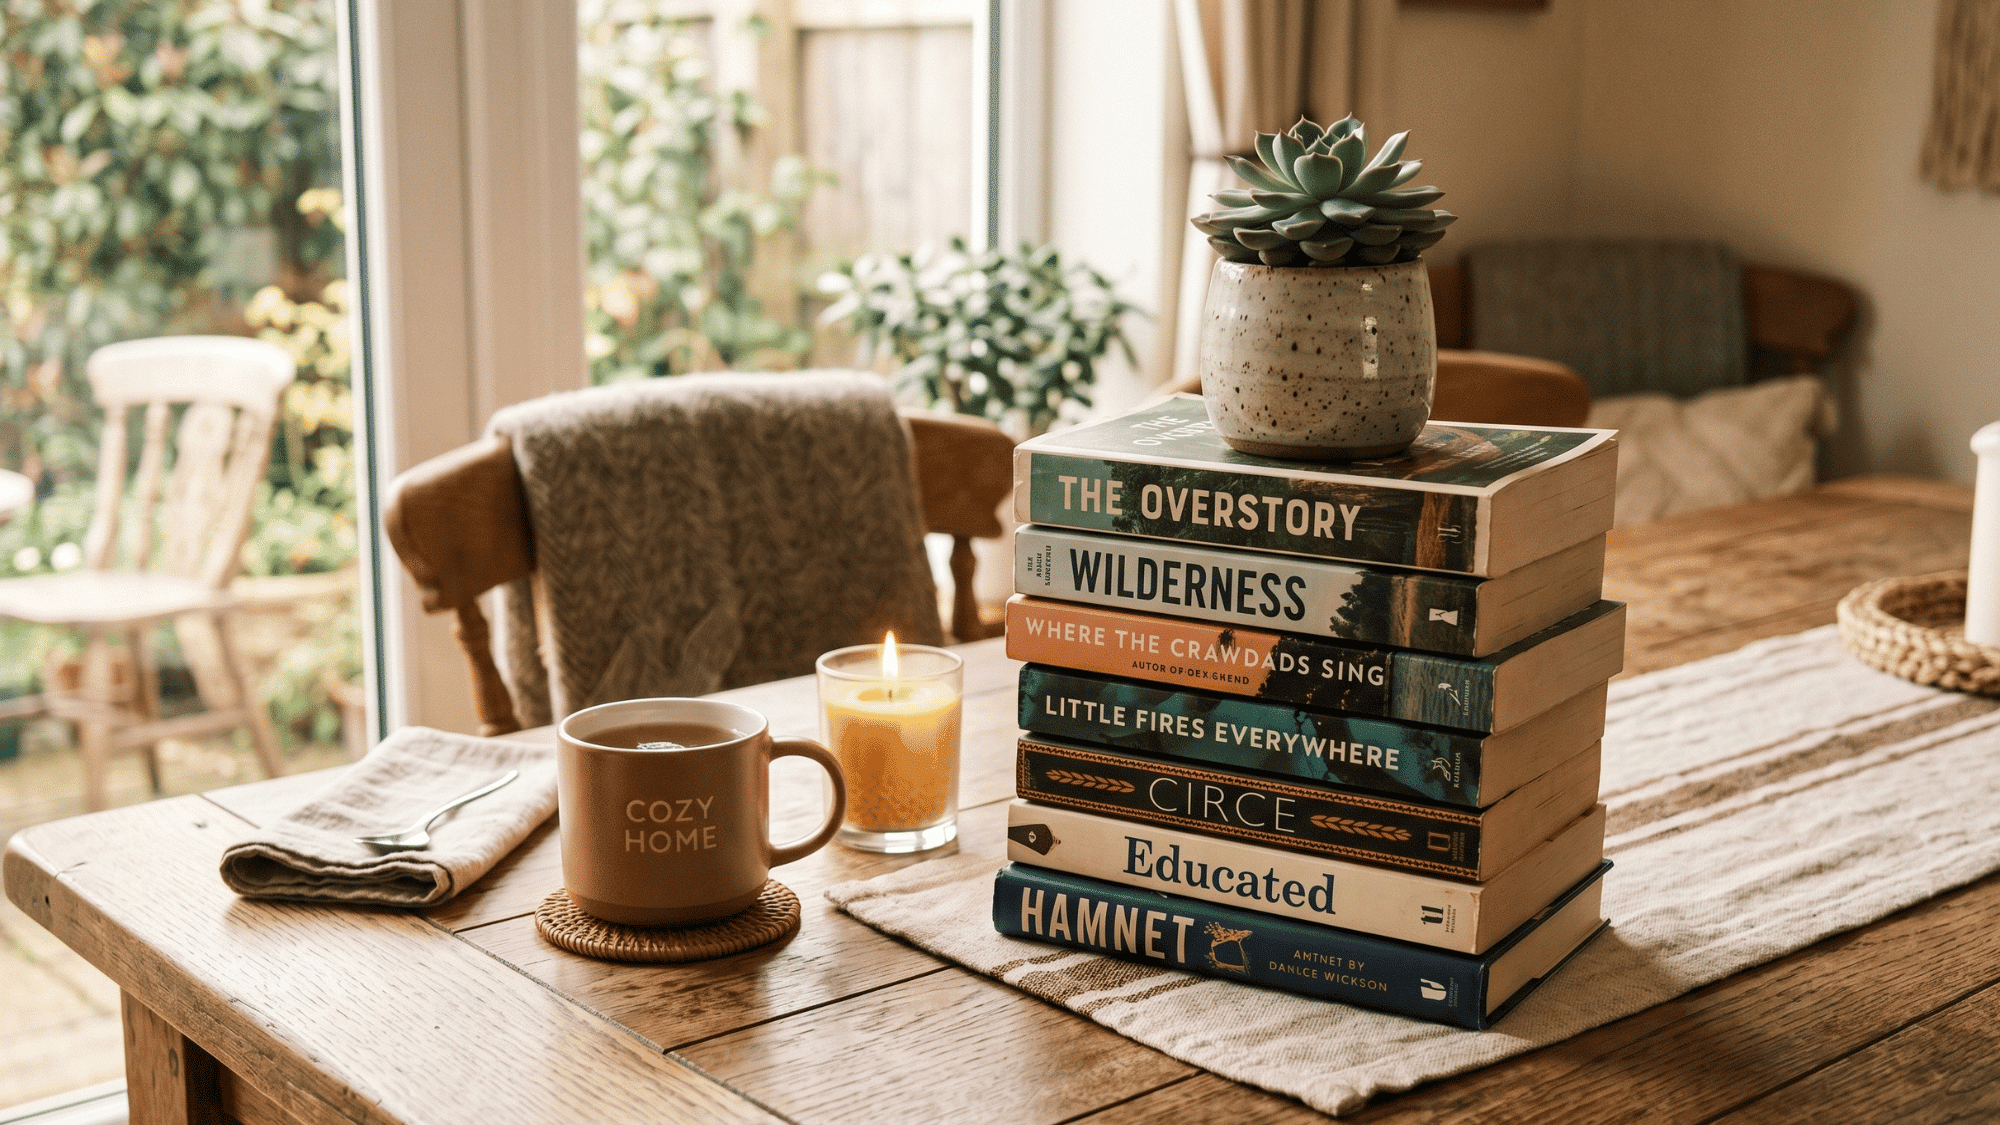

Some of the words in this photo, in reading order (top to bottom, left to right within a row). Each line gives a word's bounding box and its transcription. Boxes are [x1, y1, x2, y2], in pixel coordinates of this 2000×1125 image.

[1058, 475, 1123, 515] THE
[1141, 484, 1361, 541] OVERSTORY
[1069, 548, 1307, 621] WILDERNESS
[1025, 617, 1105, 646] WHERE
[1115, 630, 1160, 654] THE
[1170, 638, 1310, 675] CRAWDADS
[1321, 659, 1384, 686] SING
[1132, 660, 1166, 673] AUTOR
[1046, 695, 1126, 727] LITTLE
[1136, 709, 1205, 739] FIRES
[1215, 721, 1400, 771] EVERYWHERE
[626, 795, 714, 823] COZY
[1149, 777, 1296, 833] CIRCE
[625, 826, 717, 853] HOME
[1122, 836, 1336, 915] Educated
[1021, 887, 1195, 964] HAMNET
[1293, 950, 1342, 967] AMTNET
[1348, 959, 1365, 971] BY
[1324, 971, 1387, 992] WICKSON
